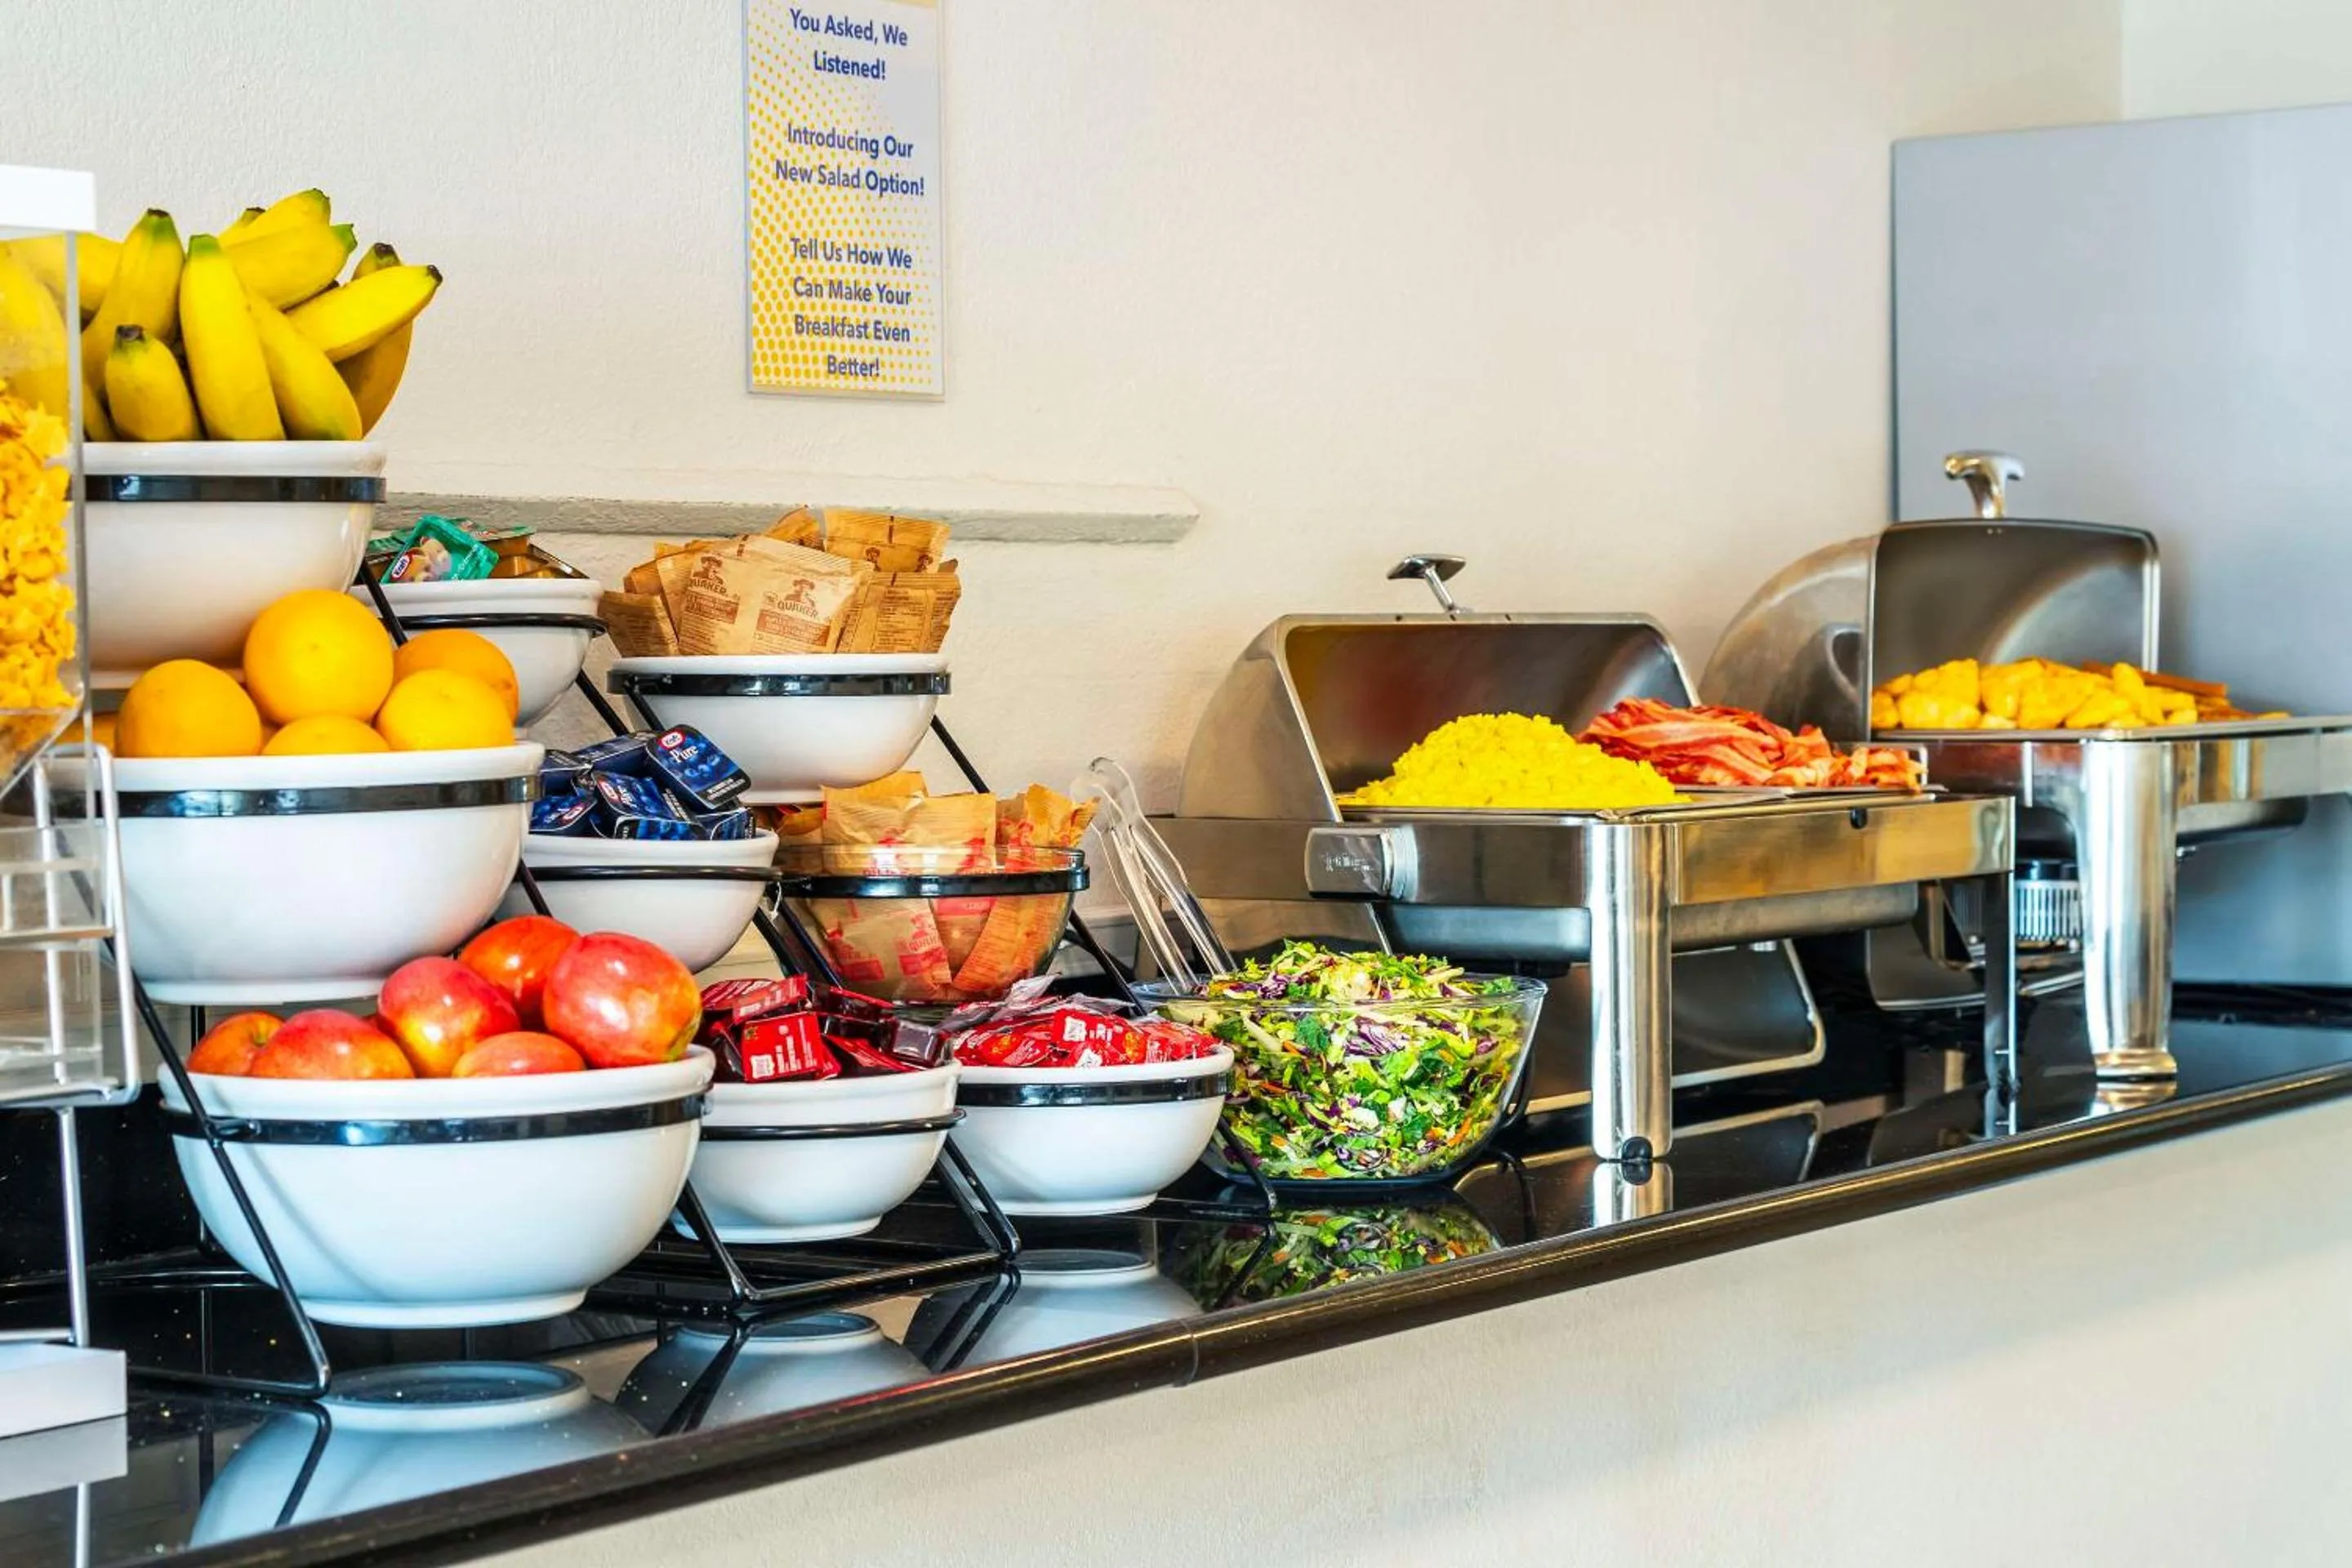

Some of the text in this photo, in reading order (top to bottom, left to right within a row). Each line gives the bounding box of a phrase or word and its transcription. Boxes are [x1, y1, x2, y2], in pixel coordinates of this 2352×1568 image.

[790, 8, 907, 46] You Asked, We
[813, 50, 886, 80] Listened!
[787, 122, 913, 159] Introducing Our
[776, 159, 924, 198] New Salad Option!
[791, 238, 911, 269] Tell Us How We
[794, 276, 911, 305] Can Make Your
[794, 314, 911, 342] Breakfast Even
[827, 354, 880, 377] Better!
